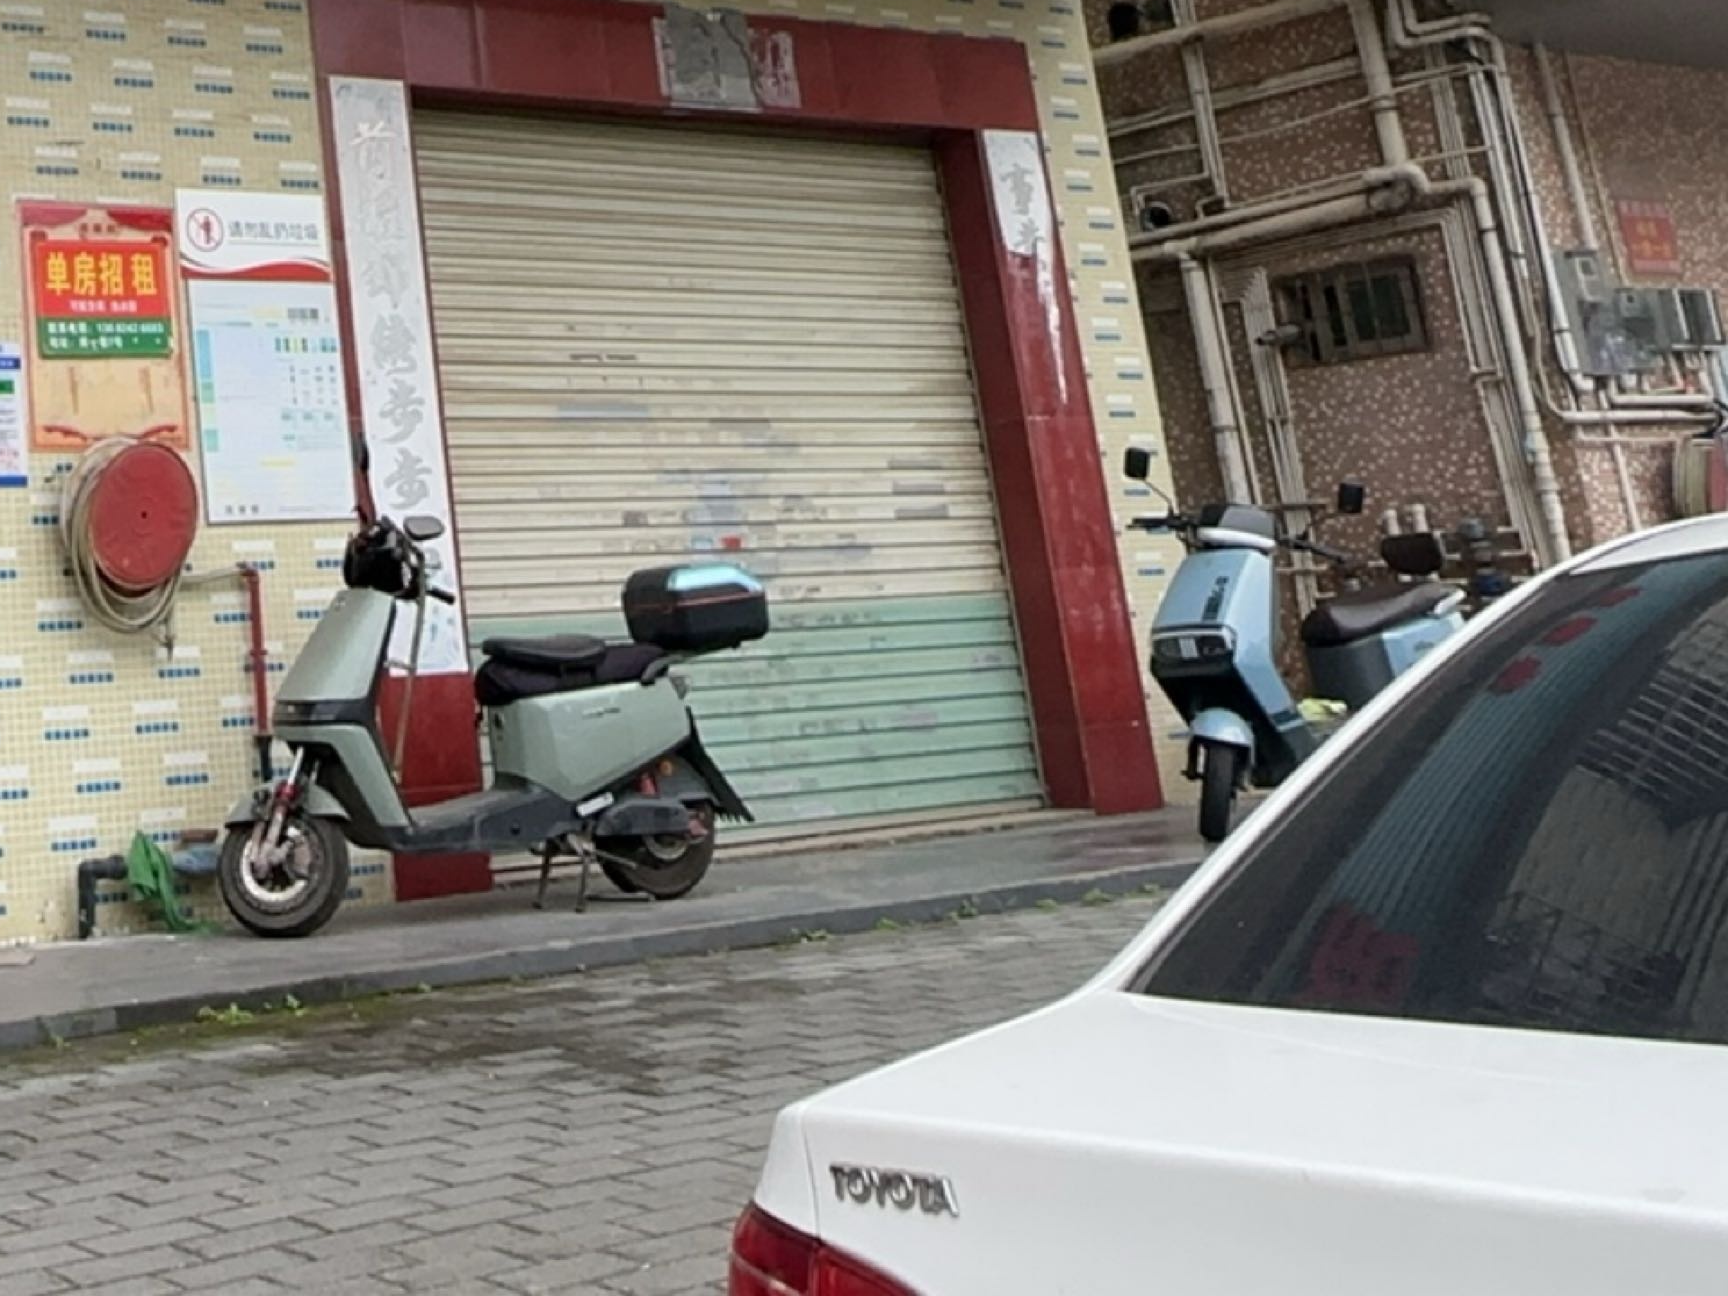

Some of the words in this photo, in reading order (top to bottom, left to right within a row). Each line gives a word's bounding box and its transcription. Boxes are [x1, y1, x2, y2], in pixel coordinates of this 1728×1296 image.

[45, 251, 158, 296] 单房招租
[828, 1162, 961, 1218] TOYOTA
